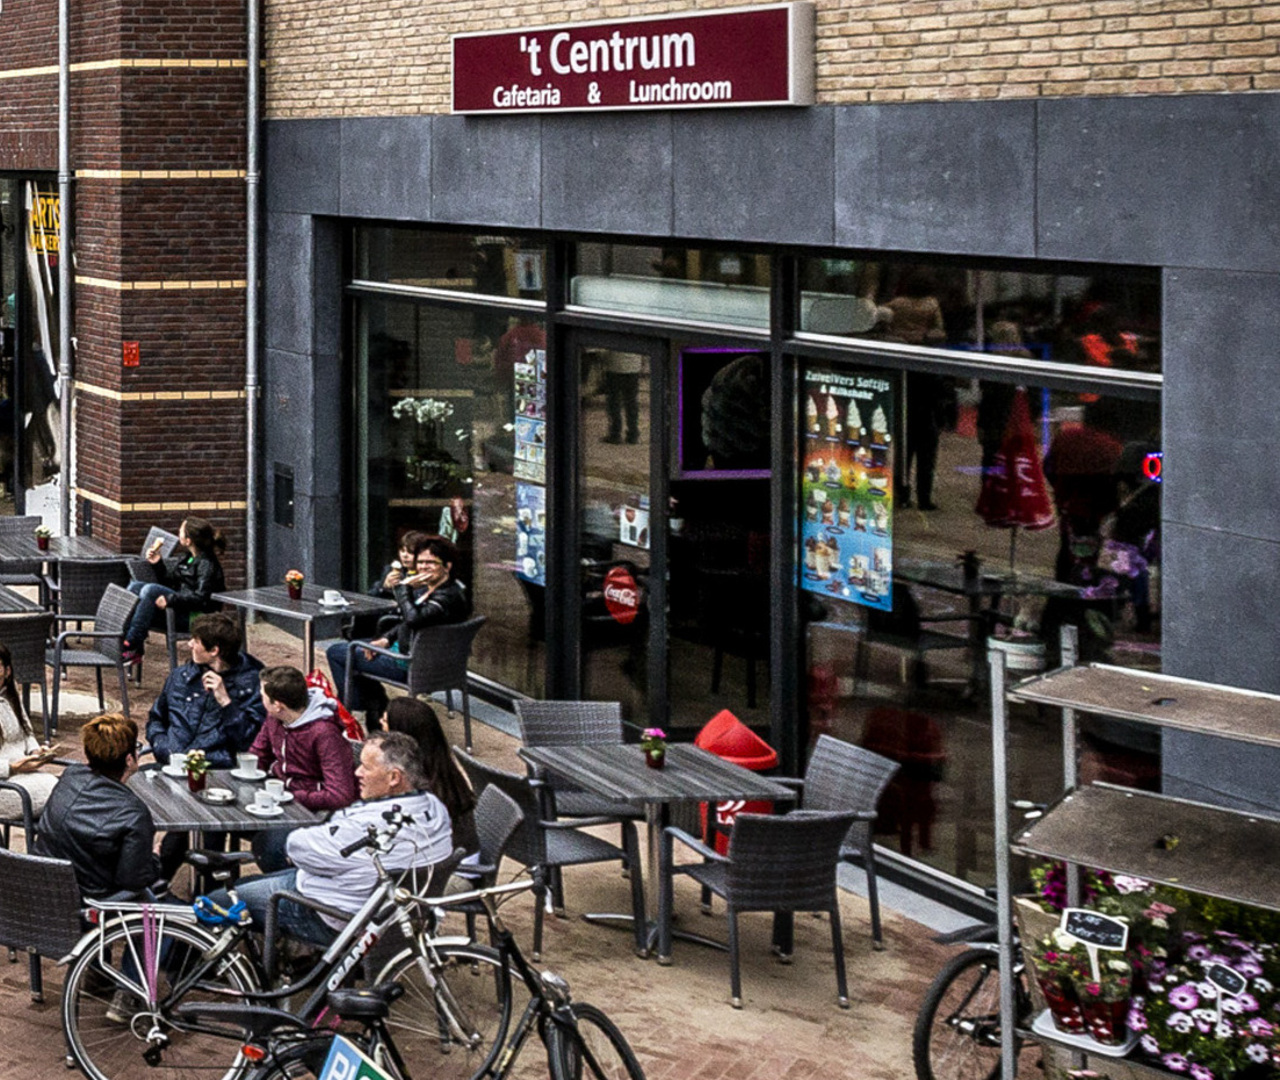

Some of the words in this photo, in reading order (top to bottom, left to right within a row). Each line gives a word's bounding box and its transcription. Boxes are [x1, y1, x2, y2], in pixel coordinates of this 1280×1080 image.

[520, 36, 542, 76] 't
[550, 31, 696, 75] Centrum
[492, 83, 561, 107] Cafetaria
[587, 82, 601, 104] &
[629, 77, 732, 103] Lunchroom
[327, 928, 375, 992] GIANT
